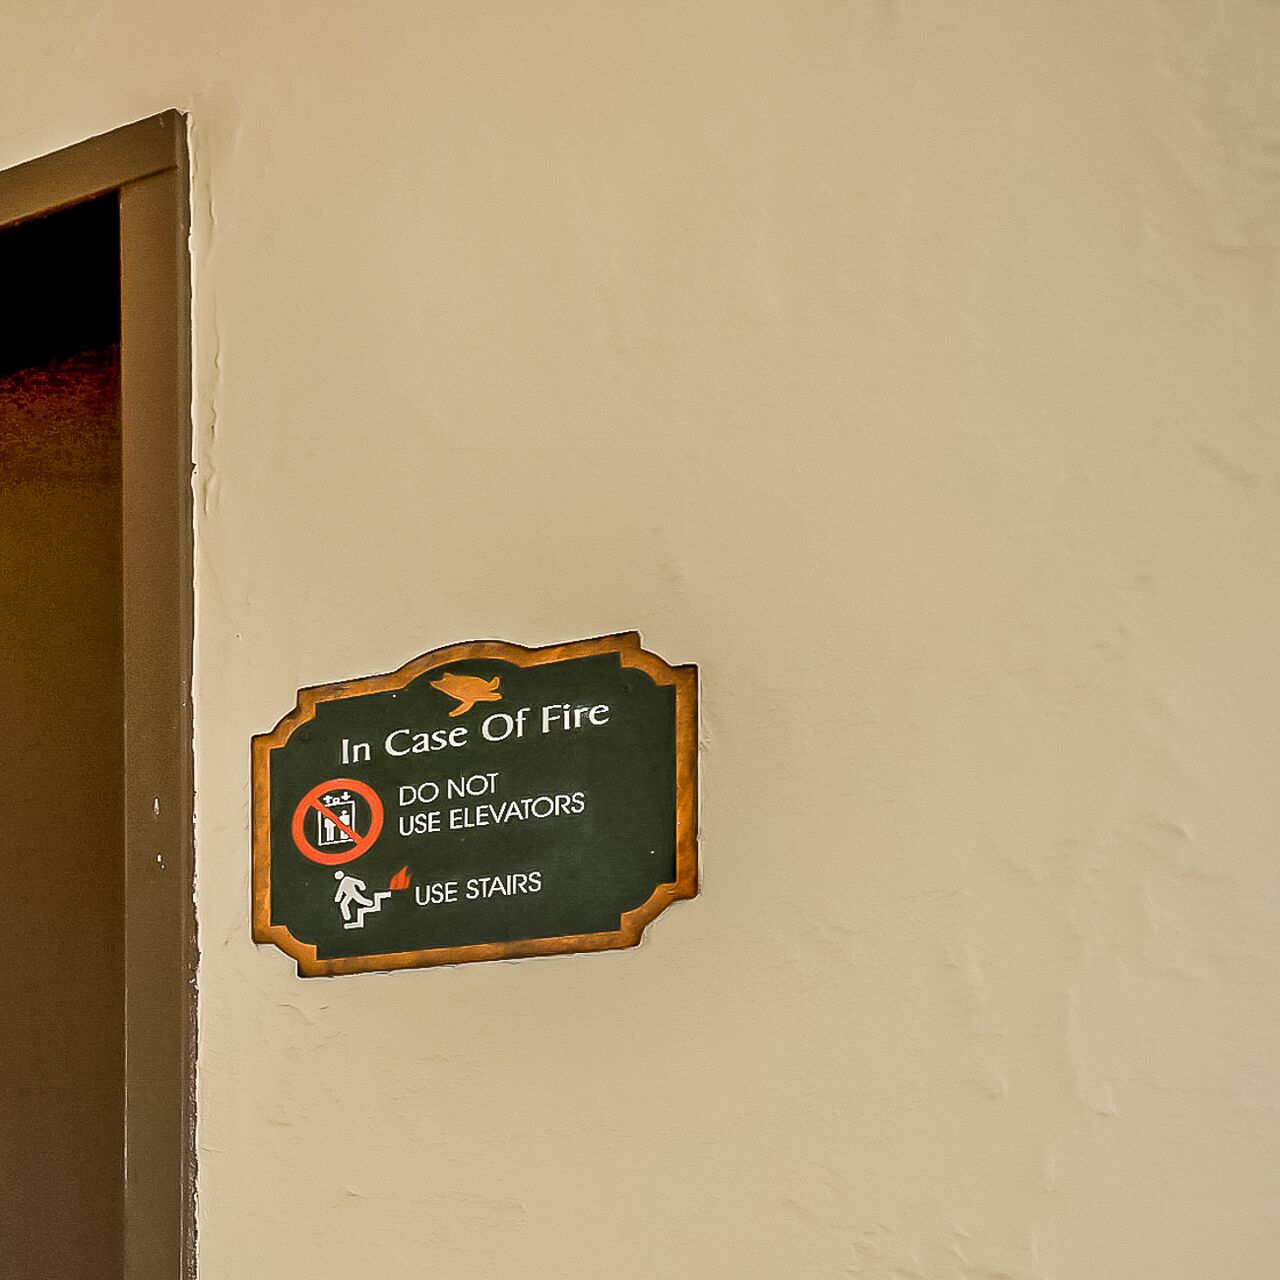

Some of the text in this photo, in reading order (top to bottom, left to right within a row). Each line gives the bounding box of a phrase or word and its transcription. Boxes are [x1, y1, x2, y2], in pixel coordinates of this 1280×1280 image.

[342, 702, 610, 765] In Case Of Fire
[399, 773, 499, 807] DO NOT
[399, 792, 586, 837] USE ELEVATORS
[415, 871, 542, 906] USE STAIRS
